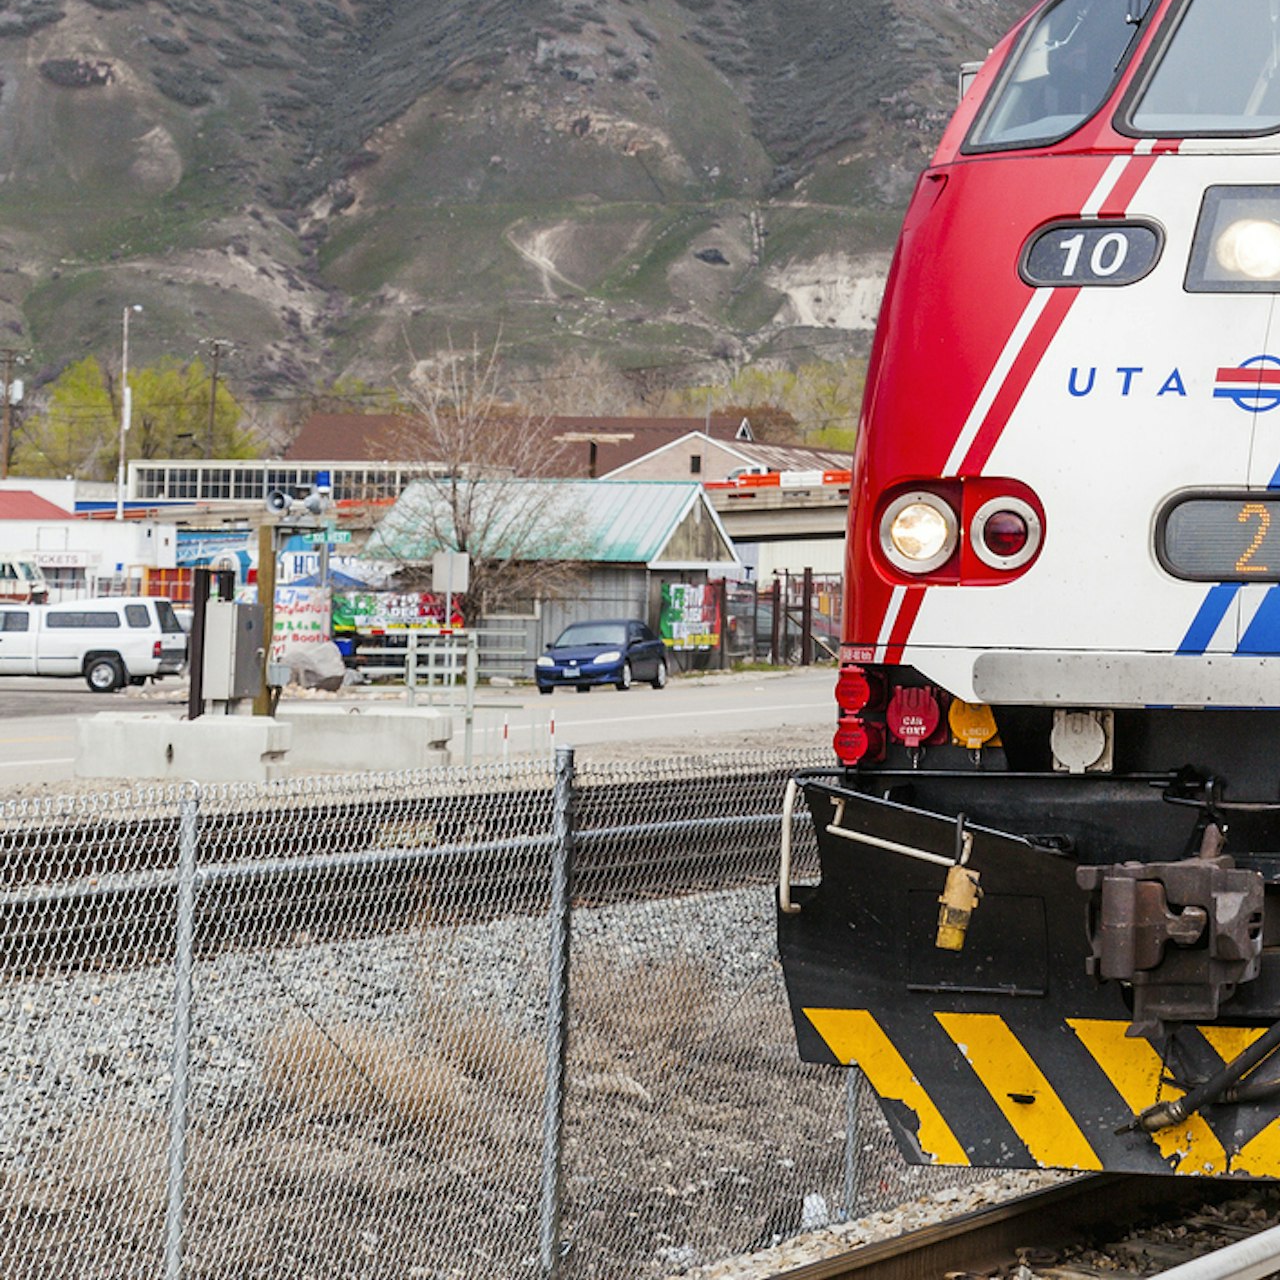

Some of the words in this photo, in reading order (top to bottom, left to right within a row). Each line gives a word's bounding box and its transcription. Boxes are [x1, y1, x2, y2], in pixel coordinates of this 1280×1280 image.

[1058, 232, 1129, 277] 10
[1067, 367, 1187, 397] UTA
[1236, 504, 1270, 572] 2
[899, 725, 927, 736] CONT
[902, 716, 923, 726] CAR
